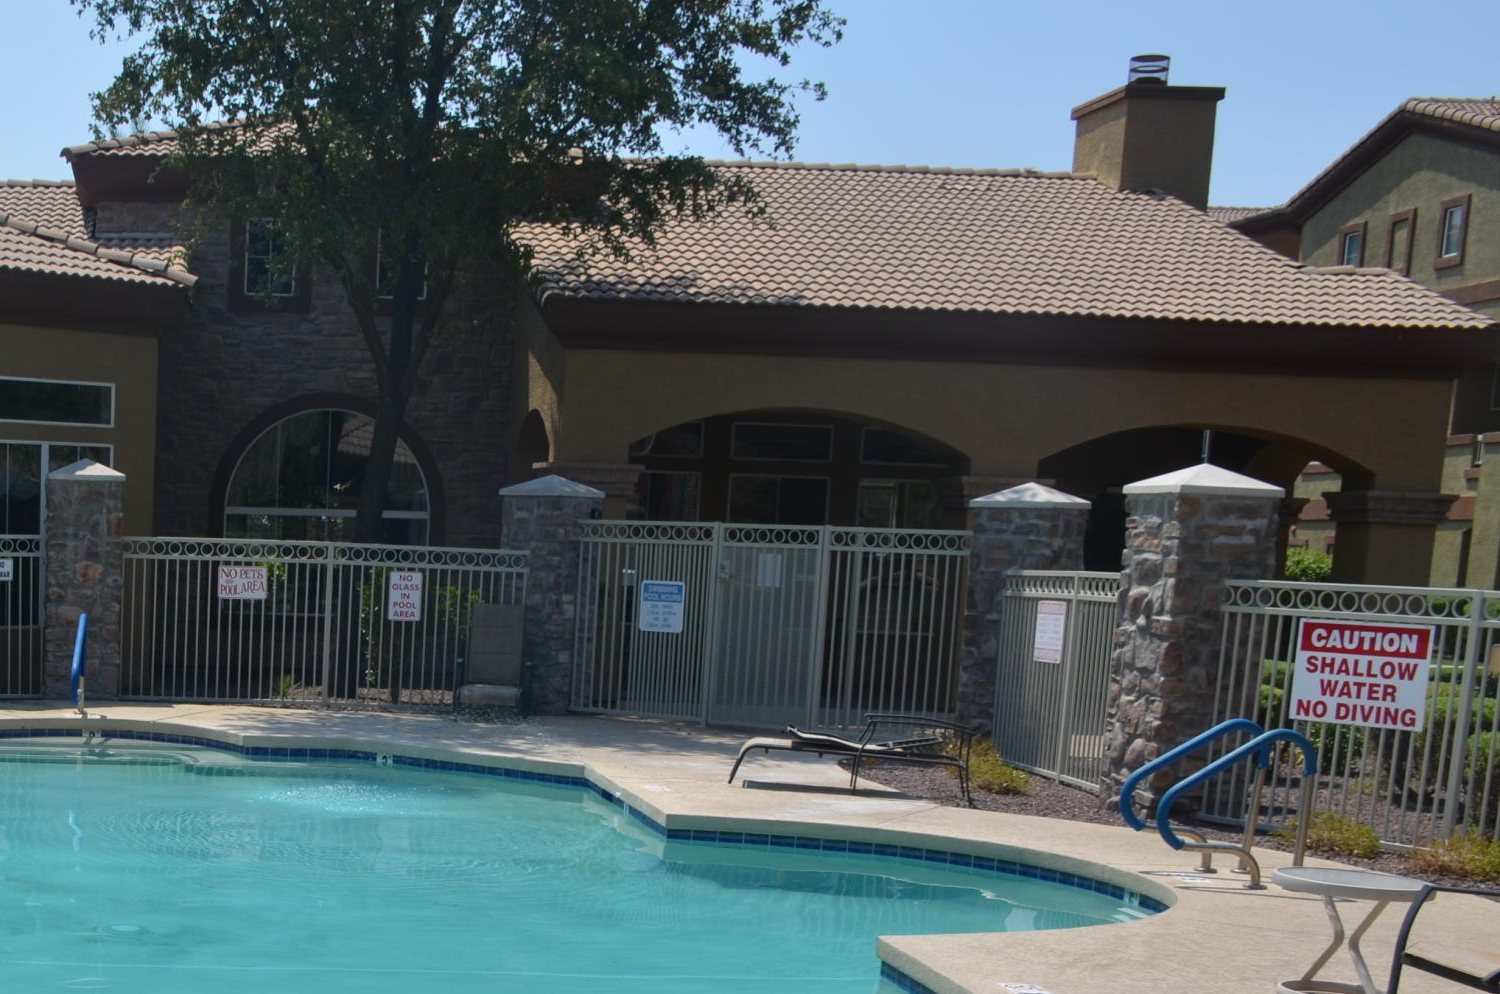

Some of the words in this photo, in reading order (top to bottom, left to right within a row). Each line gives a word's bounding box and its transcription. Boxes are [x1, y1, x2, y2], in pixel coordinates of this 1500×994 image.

[220, 568, 238, 579] NO
[240, 569, 264, 579] PETS
[400, 574, 413, 582] NO
[220, 584, 240, 595] POOL
[240, 580, 265, 594] AREA
[392, 583, 420, 591] GLASS
[400, 592, 410, 600] IN
[644, 592, 660, 600] POOL
[393, 601, 417, 609] POOL
[393, 610, 416, 618] AREA
[1311, 628, 1419, 654] CAUTION
[1305, 655, 1419, 681] SHALLOW
[1319, 679, 1397, 703] WATER
[1295, 699, 1328, 719] NO
[1334, 702, 1417, 728] DIVING
